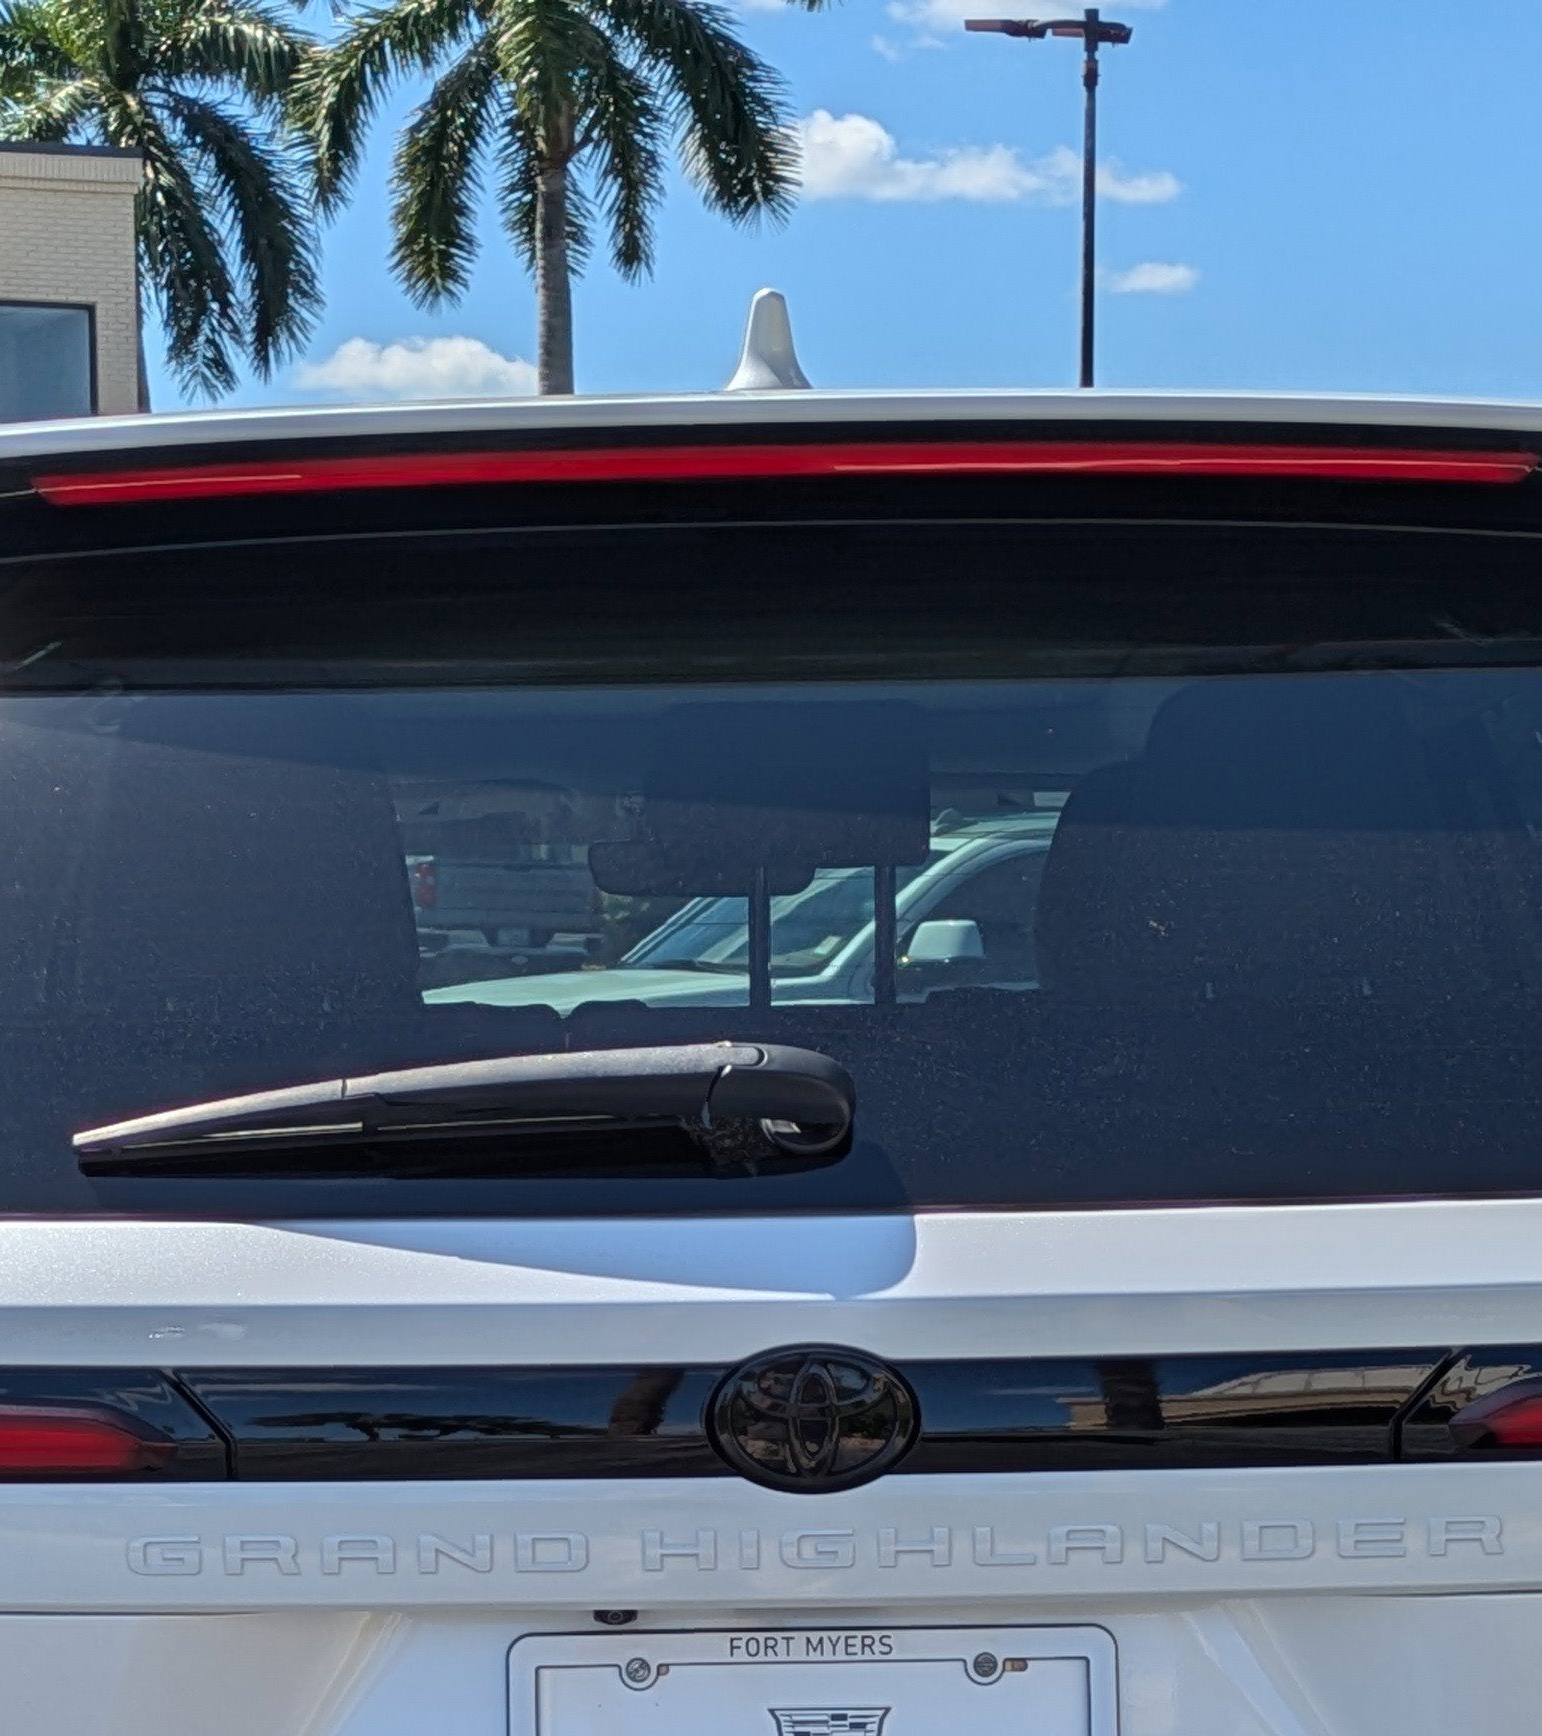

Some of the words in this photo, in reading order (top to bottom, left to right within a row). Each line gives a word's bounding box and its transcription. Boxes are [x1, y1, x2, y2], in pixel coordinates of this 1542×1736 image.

[126, 1531, 589, 1575] GRAND
[641, 1515, 1505, 1571] HIGHLANDER
[729, 1636, 796, 1658] FORT
[805, 1635, 894, 1656] MYERS
